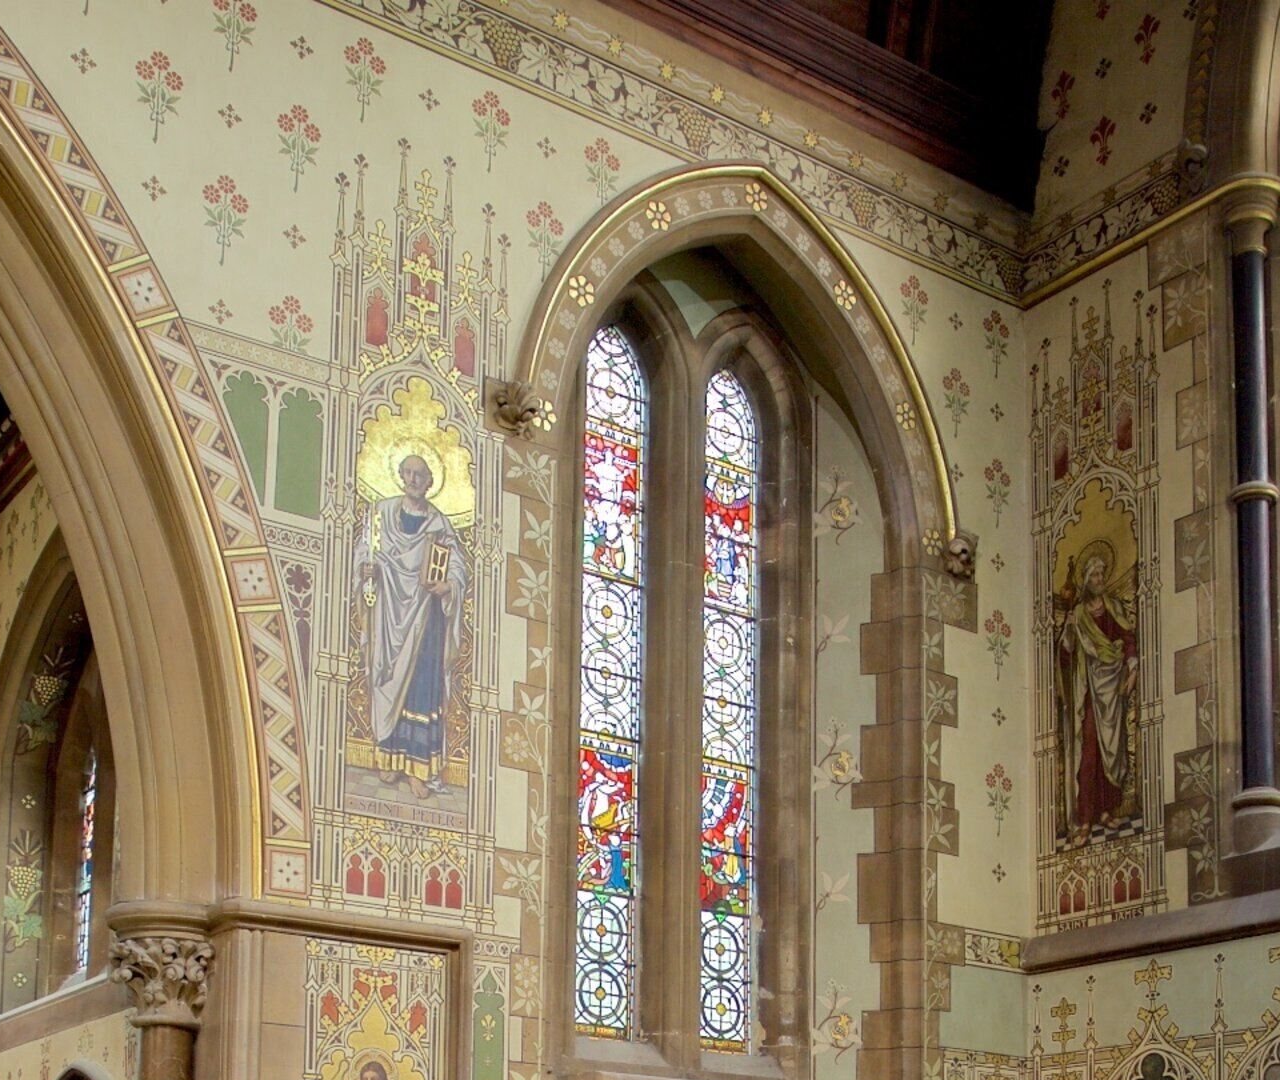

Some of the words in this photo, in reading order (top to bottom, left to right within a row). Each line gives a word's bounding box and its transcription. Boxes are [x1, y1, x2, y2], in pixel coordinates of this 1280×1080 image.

[360, 799, 403, 820] SAINT
[412, 808, 455, 828] PETER
[1059, 920, 1087, 933] SAINT
[1113, 907, 1144, 921] JAMES
